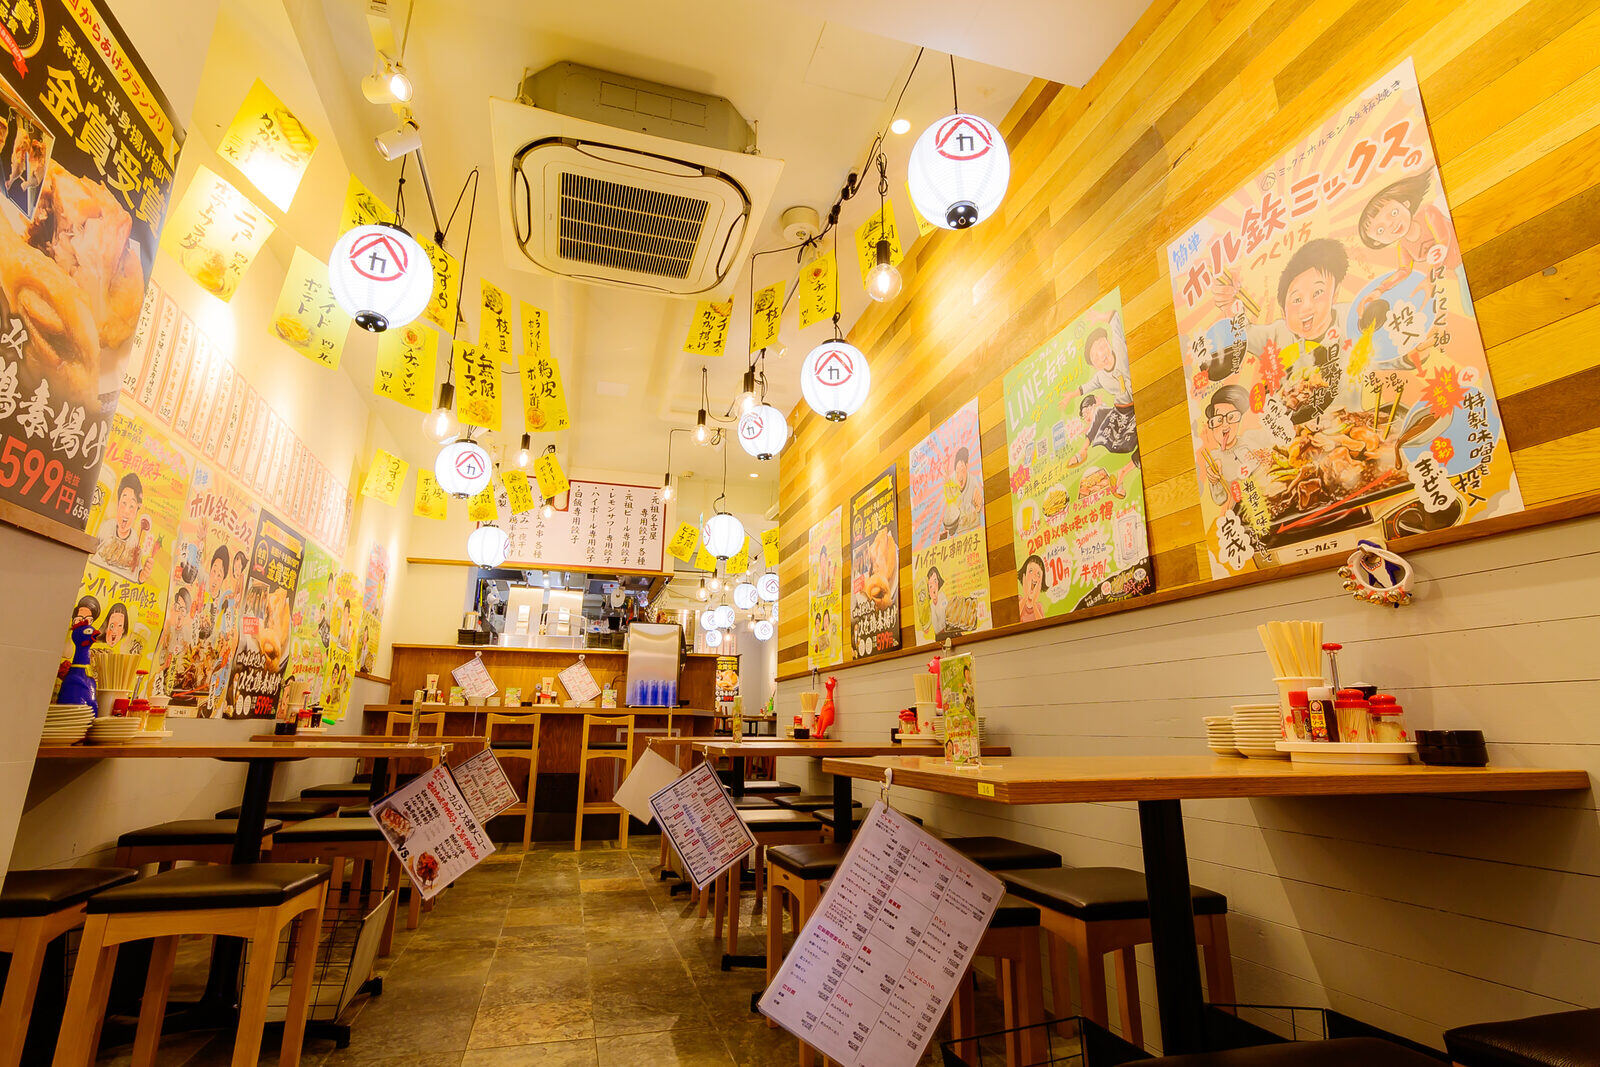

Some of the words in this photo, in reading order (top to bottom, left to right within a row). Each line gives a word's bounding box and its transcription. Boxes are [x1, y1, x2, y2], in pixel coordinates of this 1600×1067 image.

[39, 65, 165, 239] 金賞受賞
[956, 133, 974, 151] カ
[1182, 119, 1424, 308] ホル鉄ミックスの
[368, 252, 387, 274] カ
[1171, 231, 1203, 272] 簡単
[1250, 220, 1314, 271] つくり方
[1431, 247, 1442, 262] 3
[436, 253, 452, 310] うずら
[1234, 300, 1241, 313] 1
[497, 317, 510, 353] 枝豆
[1327, 328, 1340, 340] 2
[1388, 306, 1421, 347] 投入
[403, 348, 420, 401] チャンジャ
[462, 349, 478, 398] ピーマン
[477, 354, 496, 400] 無限
[527, 368, 540, 409] ポン酢
[538, 359, 558, 399] 鶏皮
[827, 366, 841, 380] カ
[1320, 343, 1343, 400] 具材を
[1461, 371, 1475, 382] 4
[0, 435, 64, 505] 599
[105, 441, 162, 482] ル専用餃子
[466, 463, 476, 476] カ
[1240, 465, 1249, 477] 5
[1414, 456, 1449, 508] まぜる
[1454, 468, 1487, 507] 投入
[638, 508, 649, 545] 専用餃子
[864, 501, 895, 538] 金賞受賞
[637, 547, 647, 566] 各種
[914, 533, 981, 571] ハイボール専用餃子
[1295, 540, 1338, 558] ニューカムラ
[267, 557, 298, 592] 金賞受賞
